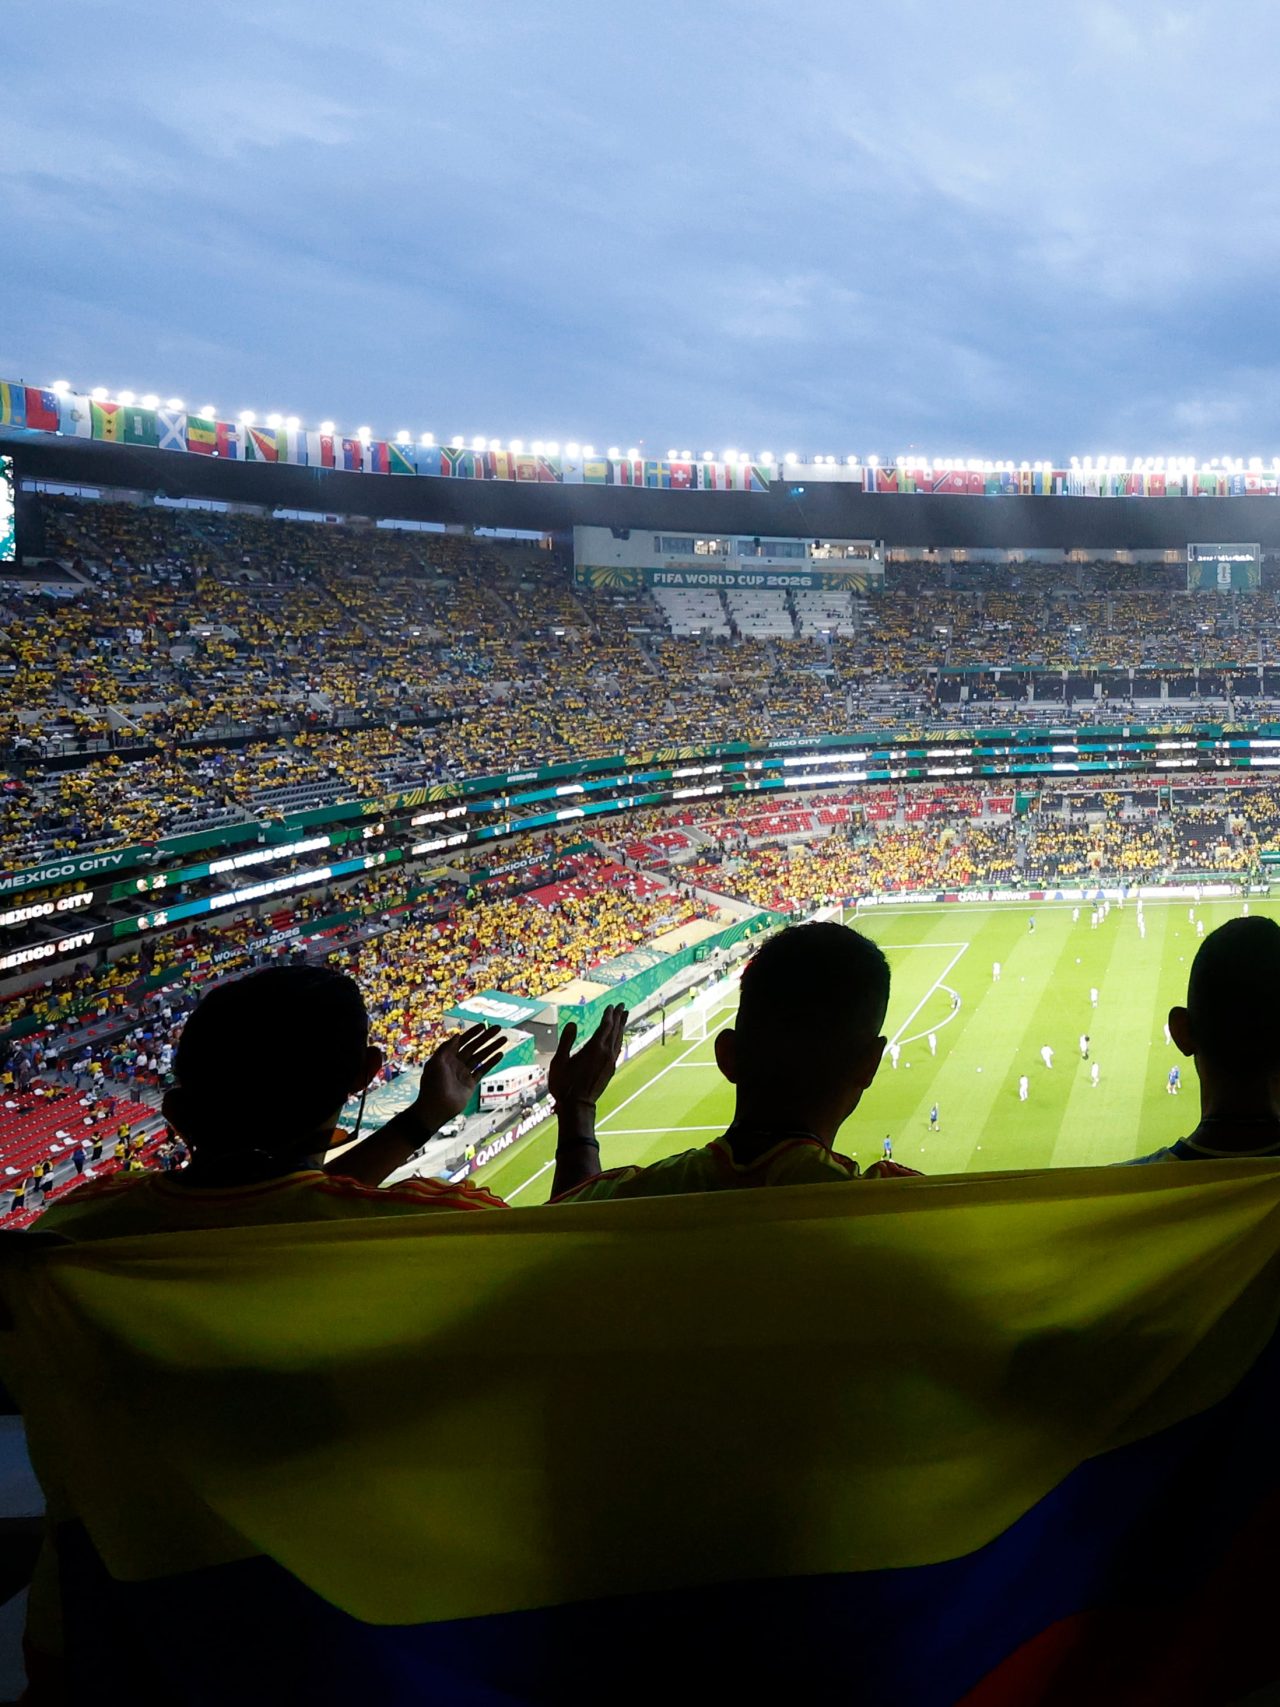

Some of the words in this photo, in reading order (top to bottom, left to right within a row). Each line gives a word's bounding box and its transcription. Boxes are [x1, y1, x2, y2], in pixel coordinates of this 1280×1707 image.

[653, 572, 683, 584] FIFA
[685, 573, 735, 585] WORLD
[737, 575, 764, 586] CUP
[767, 576, 812, 587] 2026
[0, 864, 75, 890] MEXICO
[79, 853, 124, 871] CITY
[489, 860, 527, 876] MEXICO
[529, 853, 550, 865] CITY
[57, 892, 94, 911] CITY
[957, 891, 989, 902] QATAR
[58, 932, 95, 951] CITY
[270, 927, 300, 943] 2026
[476, 1131, 513, 1166] QATAR
